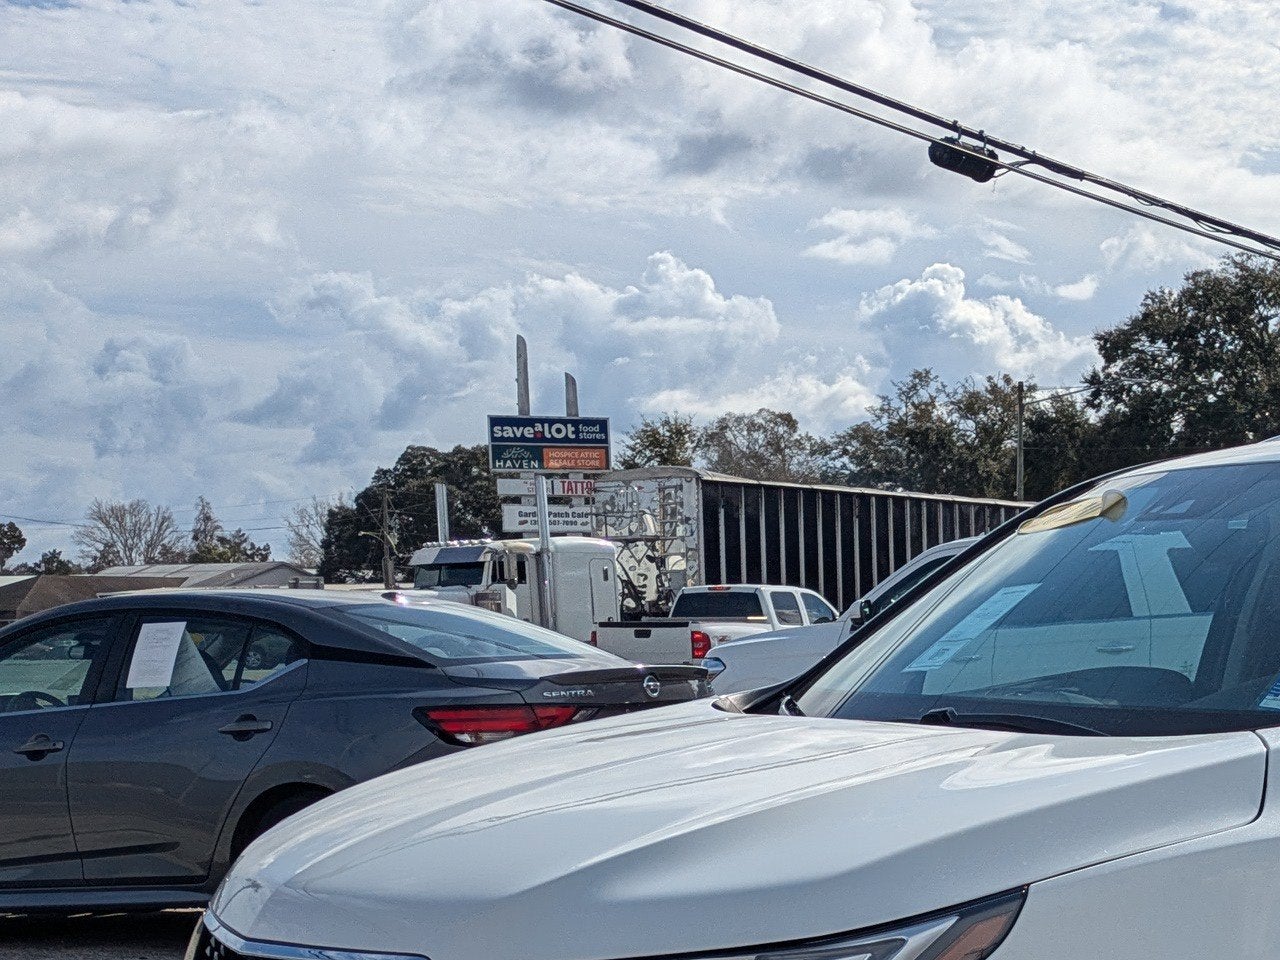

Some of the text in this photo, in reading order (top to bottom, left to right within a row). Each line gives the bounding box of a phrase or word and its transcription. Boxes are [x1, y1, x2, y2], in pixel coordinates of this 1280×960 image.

[579, 424, 600, 432] food
[578, 432, 606, 440] stores
[579, 451, 600, 459] ATTIC
[495, 460, 539, 469] HAVEN
[577, 459, 600, 467] STORE
[560, 480, 595, 495] TATTO
[548, 511, 570, 519] Patch
[543, 689, 594, 698] SENTRA
